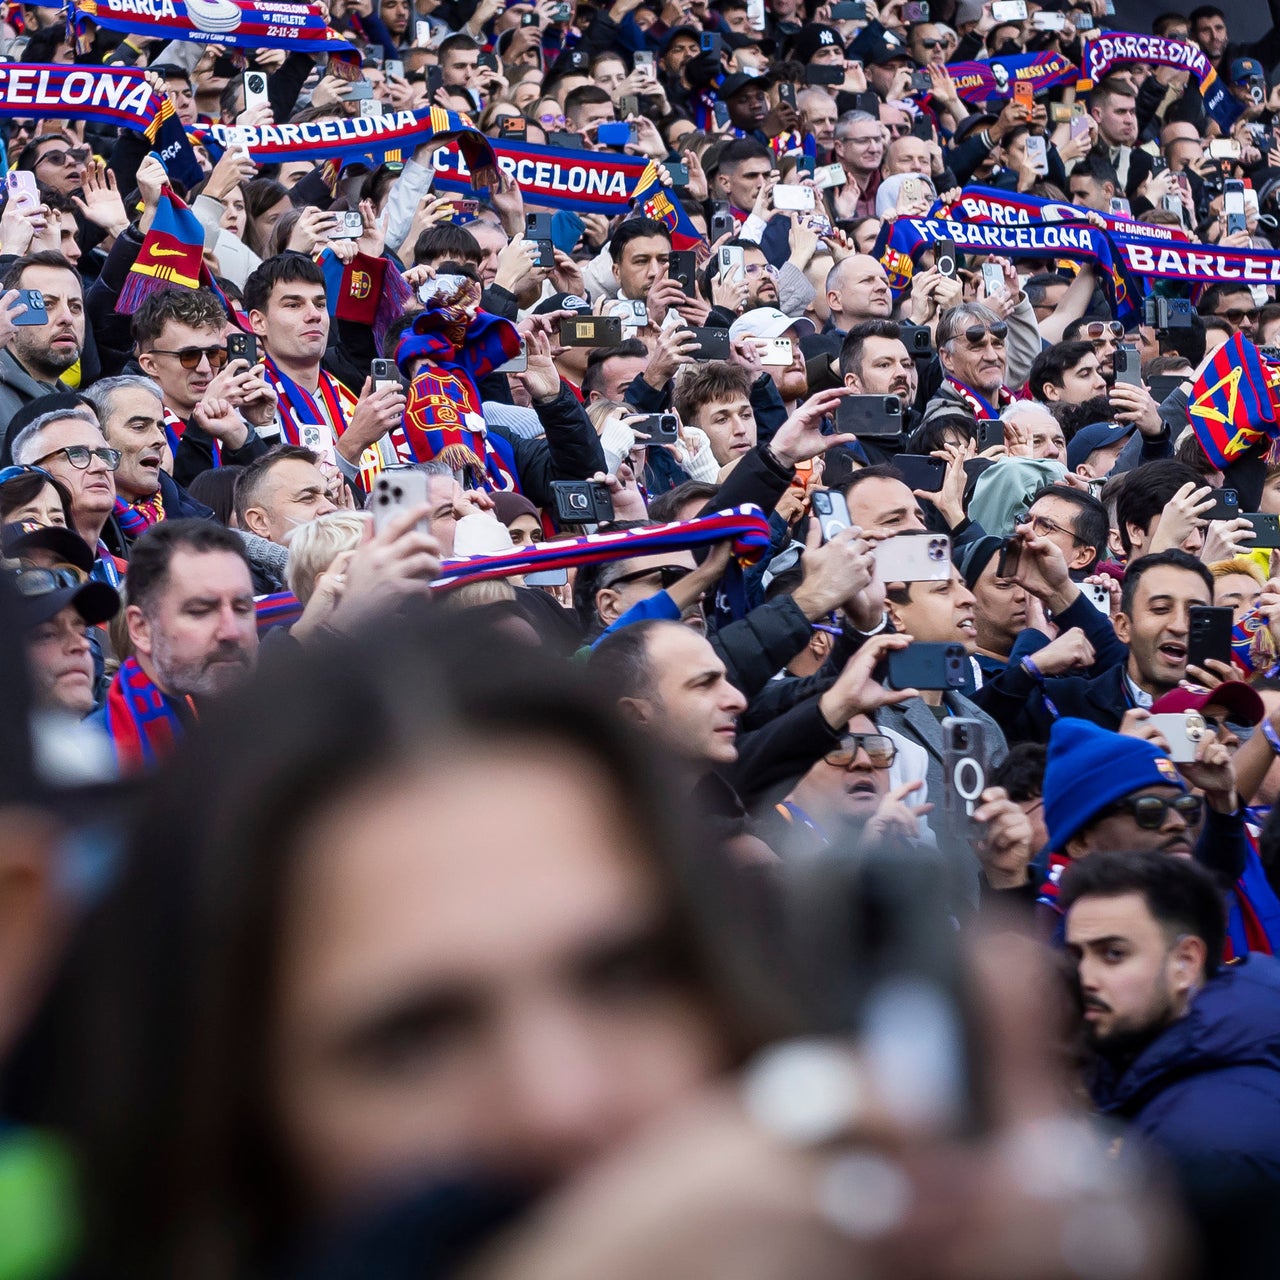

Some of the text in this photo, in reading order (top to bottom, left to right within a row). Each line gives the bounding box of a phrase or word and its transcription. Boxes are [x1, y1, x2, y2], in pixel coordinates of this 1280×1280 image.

[264, 2, 311, 15] BARCELONA
[271, 14, 307, 26] ATHLETIC
[1099, 36, 1206, 73] BARCELONA
[1015, 61, 1060, 80] MESSI 10
[242, 110, 418, 147] BARCELONA
[910, 219, 1094, 250] FC BARCELONA
[1114, 221, 1125, 233] FC
[1125, 223, 1173, 239] BARCELONA
